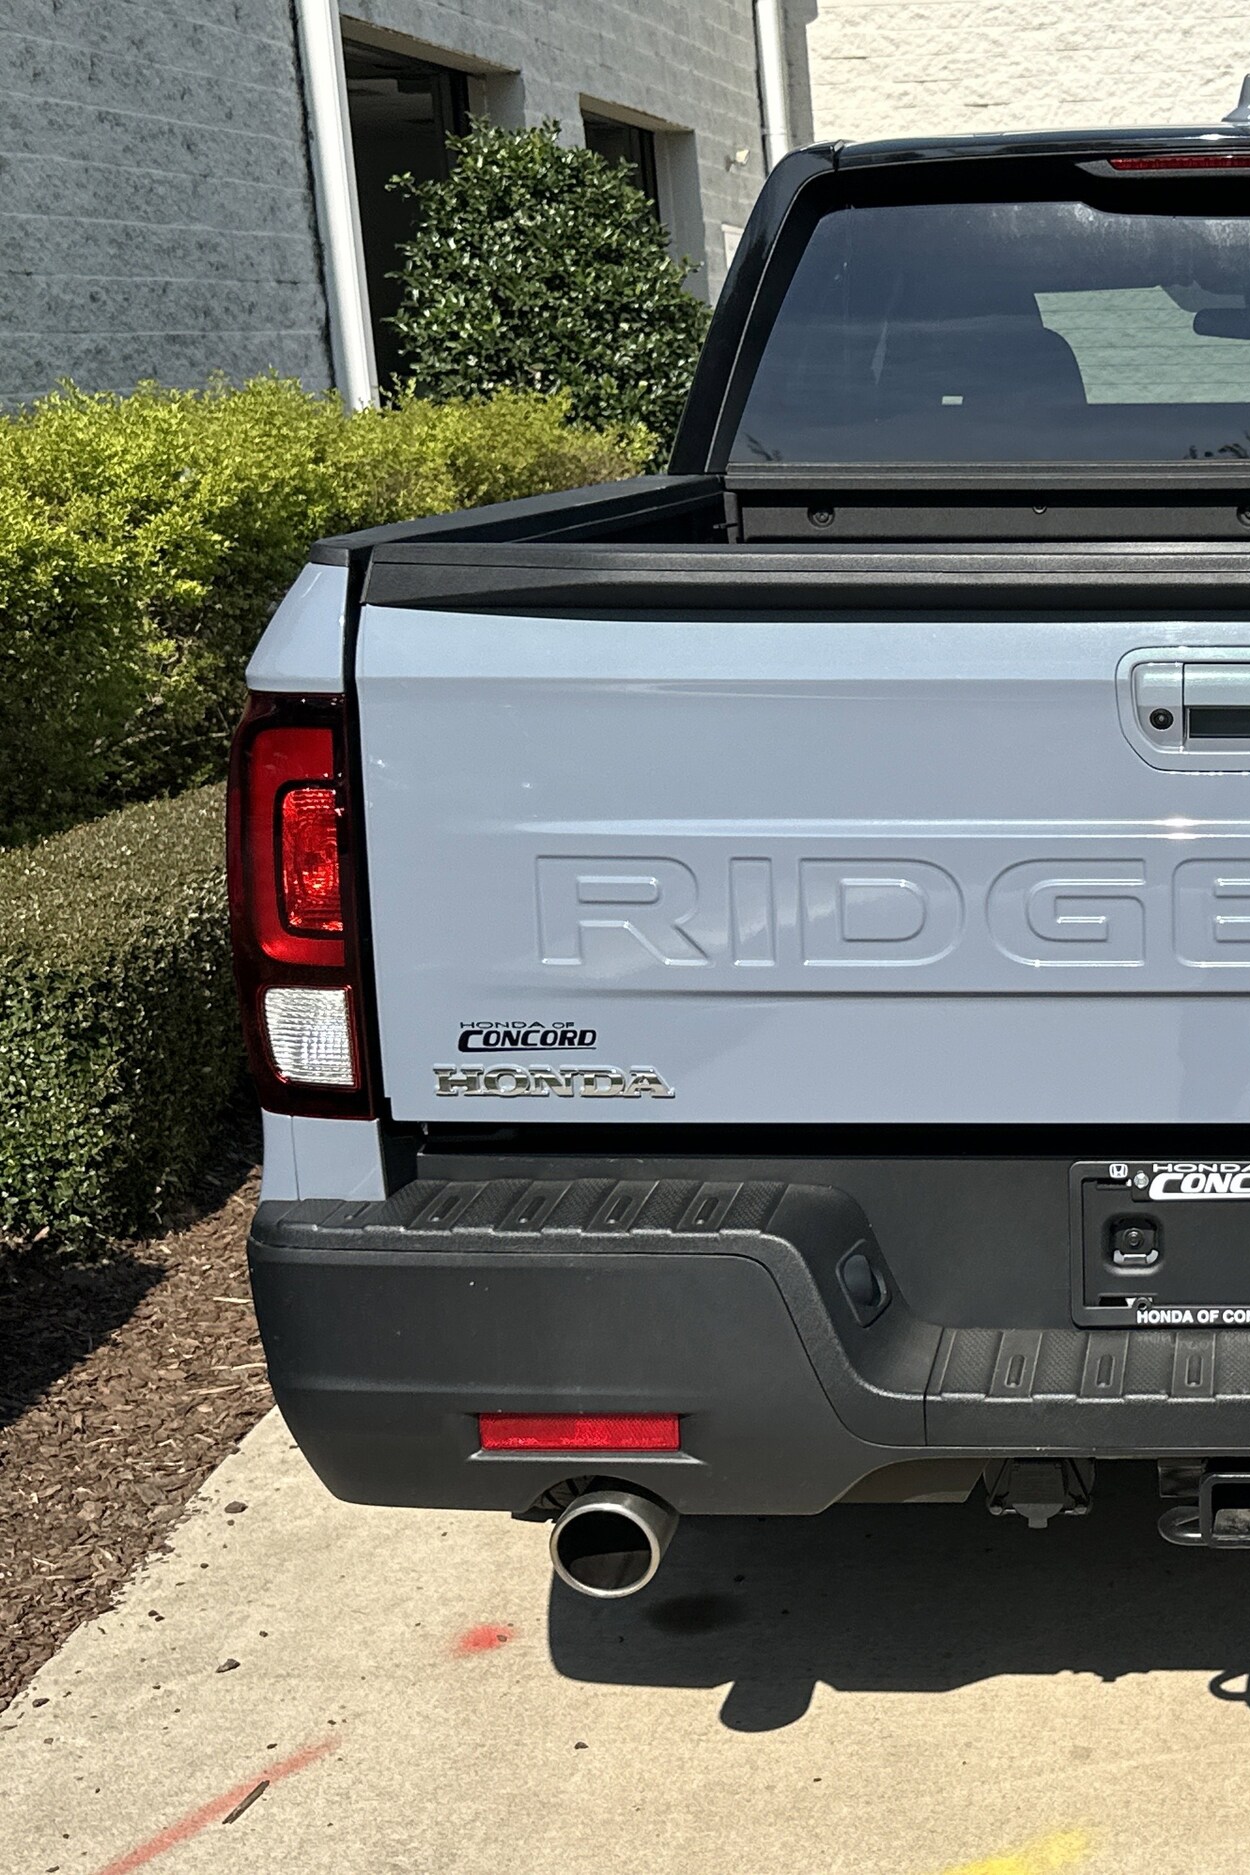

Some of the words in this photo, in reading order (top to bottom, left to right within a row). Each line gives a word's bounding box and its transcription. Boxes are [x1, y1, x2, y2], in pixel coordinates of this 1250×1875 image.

[460, 1021, 546, 1029] HONDA
[458, 1029, 598, 1053] CONCORD
[433, 1063, 676, 1098] HONDA
[1136, 1310, 1194, 1324] HONDA
[1197, 1310, 1219, 1324] OF
